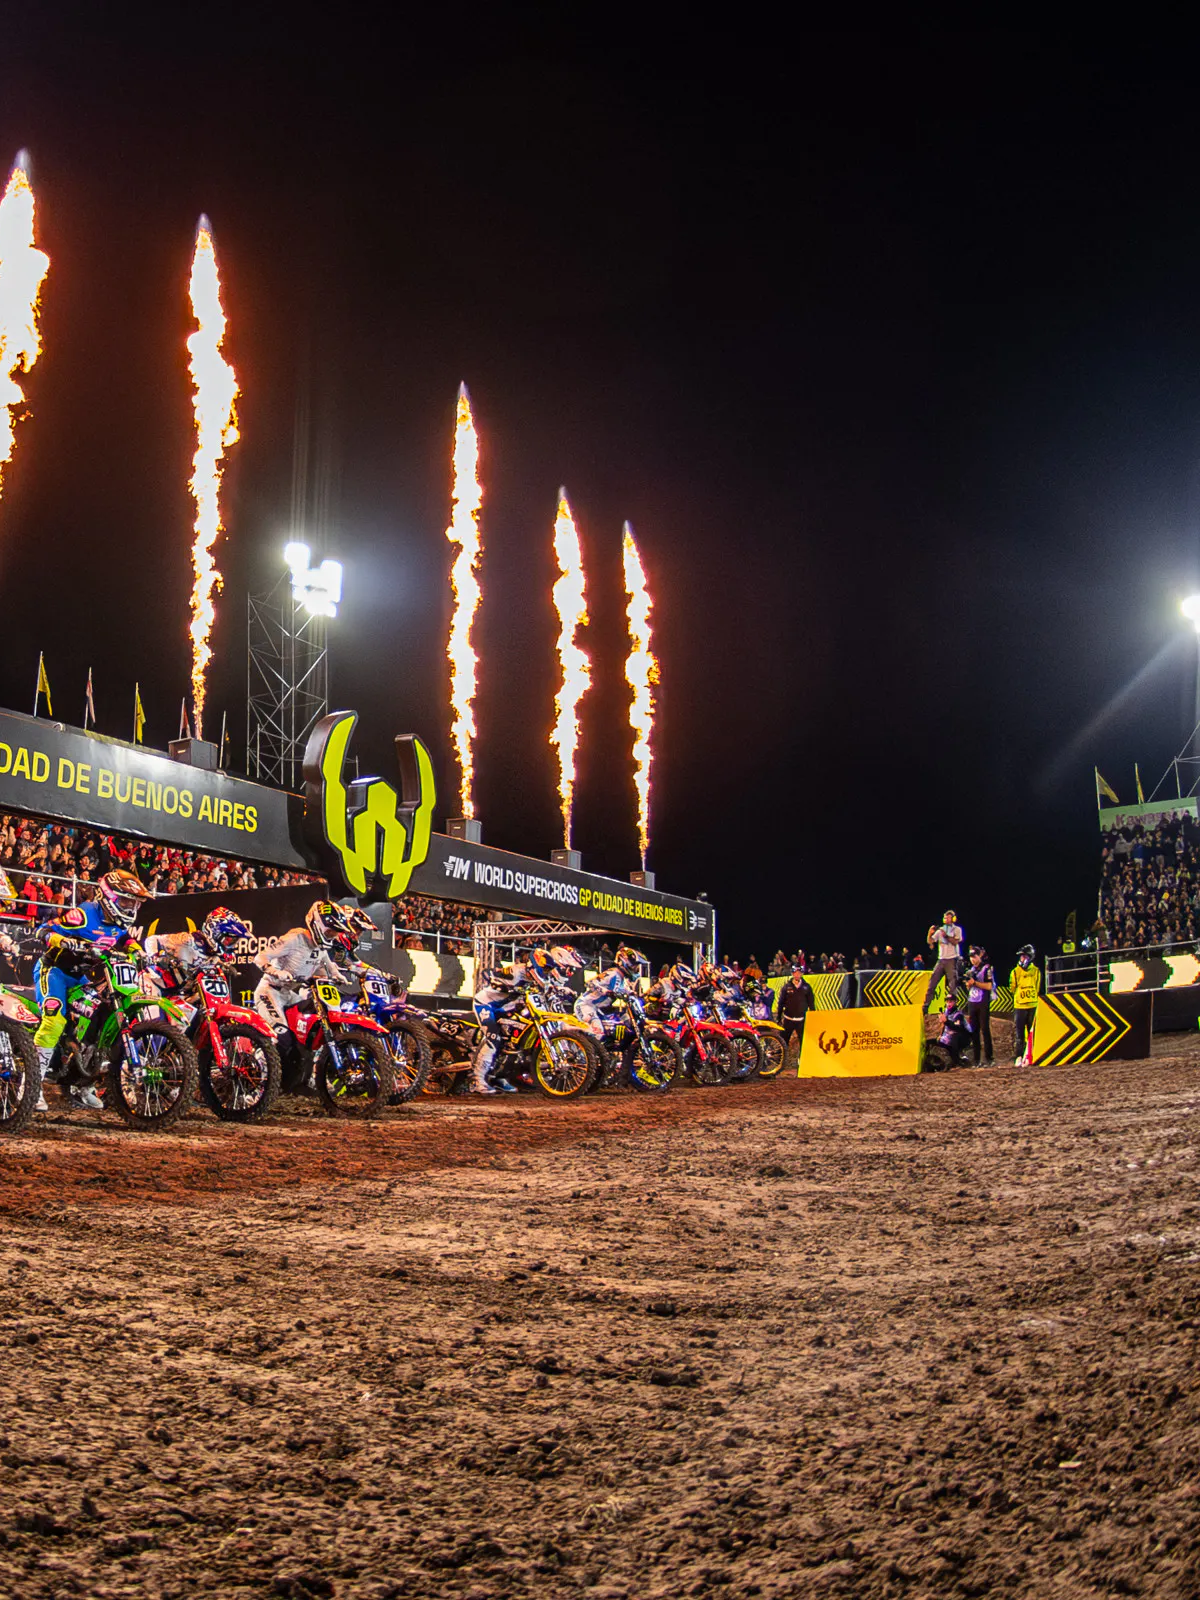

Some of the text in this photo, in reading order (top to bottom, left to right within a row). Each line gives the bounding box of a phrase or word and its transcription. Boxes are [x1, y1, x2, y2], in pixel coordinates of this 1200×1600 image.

[57, 758, 91, 794] DE
[97, 769, 193, 818] BUENOS
[198, 795, 258, 833] AIRES
[443, 855, 471, 881] FIM
[474, 861, 514, 890] WORLD
[514, 873, 578, 905] SUPERCROSS
[579, 887, 592, 905] GP
[592, 891, 623, 913] CIUDAD
[624, 898, 634, 916] DE
[635, 901, 663, 922] BUENOS
[664, 907, 683, 926] AIRES
[321, 986, 339, 1001] 99
[850, 1037, 903, 1046] SUPERCROSS
[851, 1030, 880, 1039] WORLD
